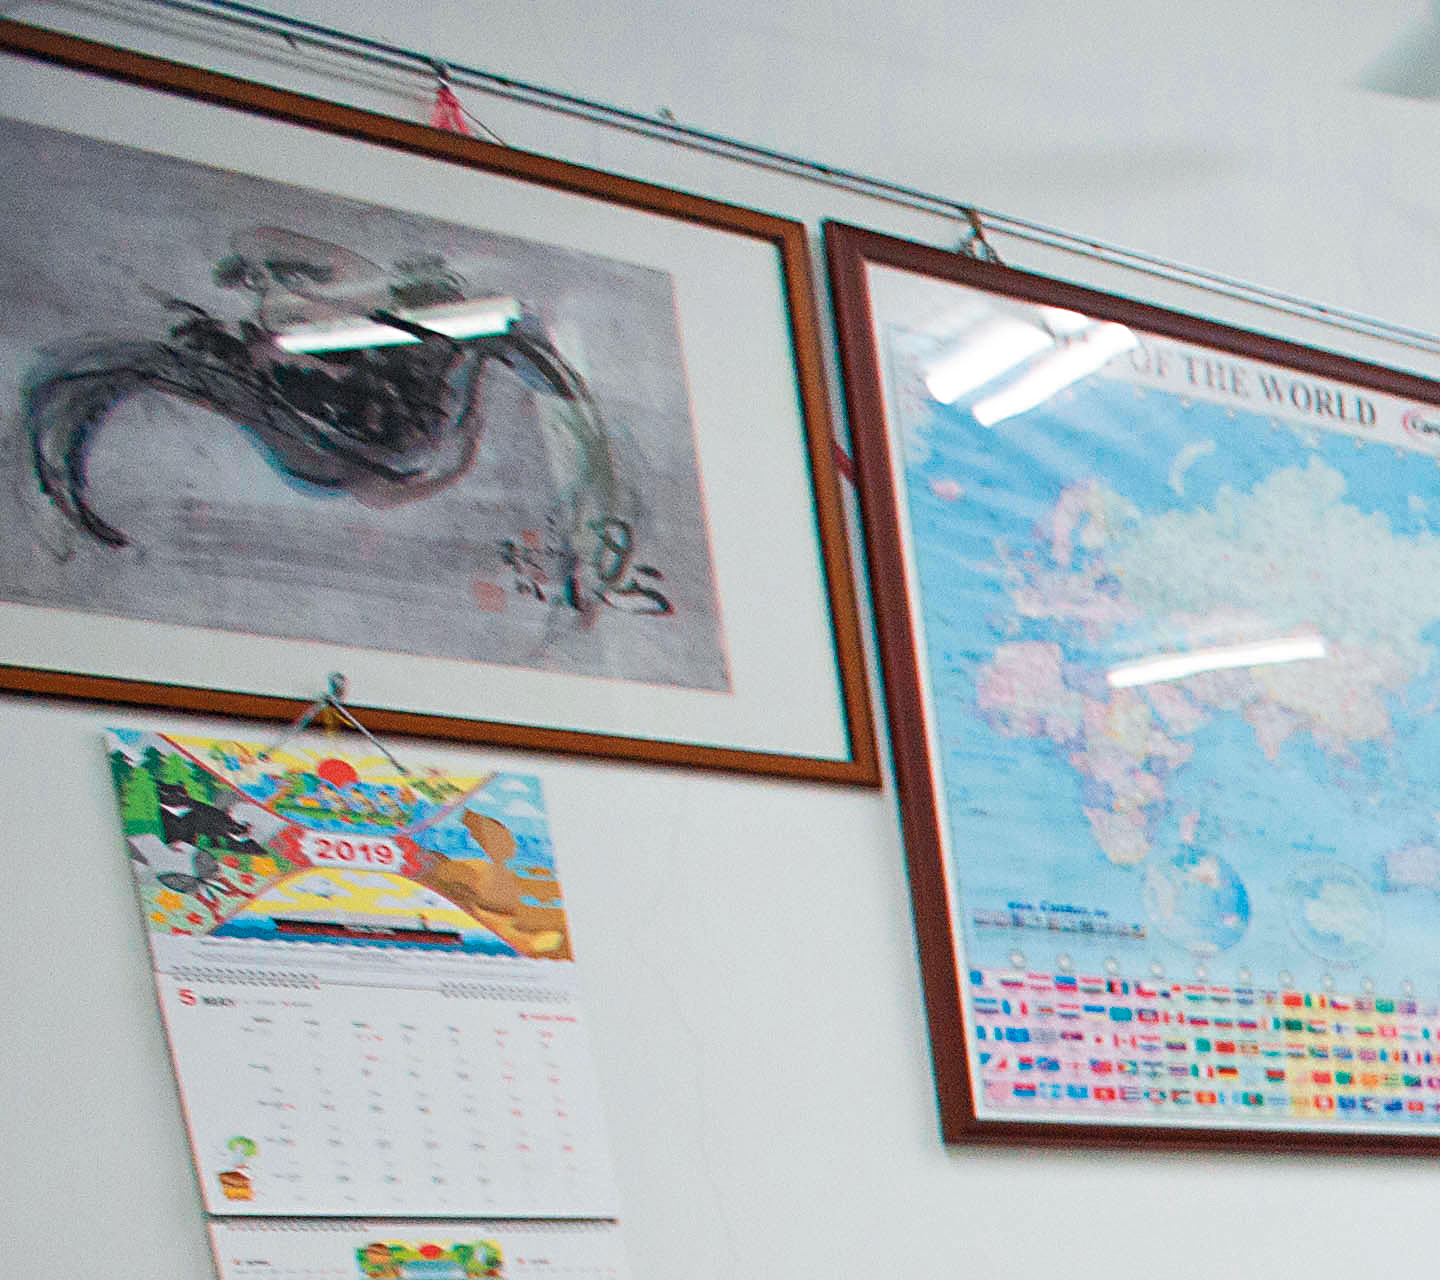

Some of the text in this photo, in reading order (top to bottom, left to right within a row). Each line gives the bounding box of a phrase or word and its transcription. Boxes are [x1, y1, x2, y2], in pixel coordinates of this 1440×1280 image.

[1184, 355, 1249, 396] THE
[1259, 373, 1378, 426] WORLD
[313, 835, 395, 864] 2019
